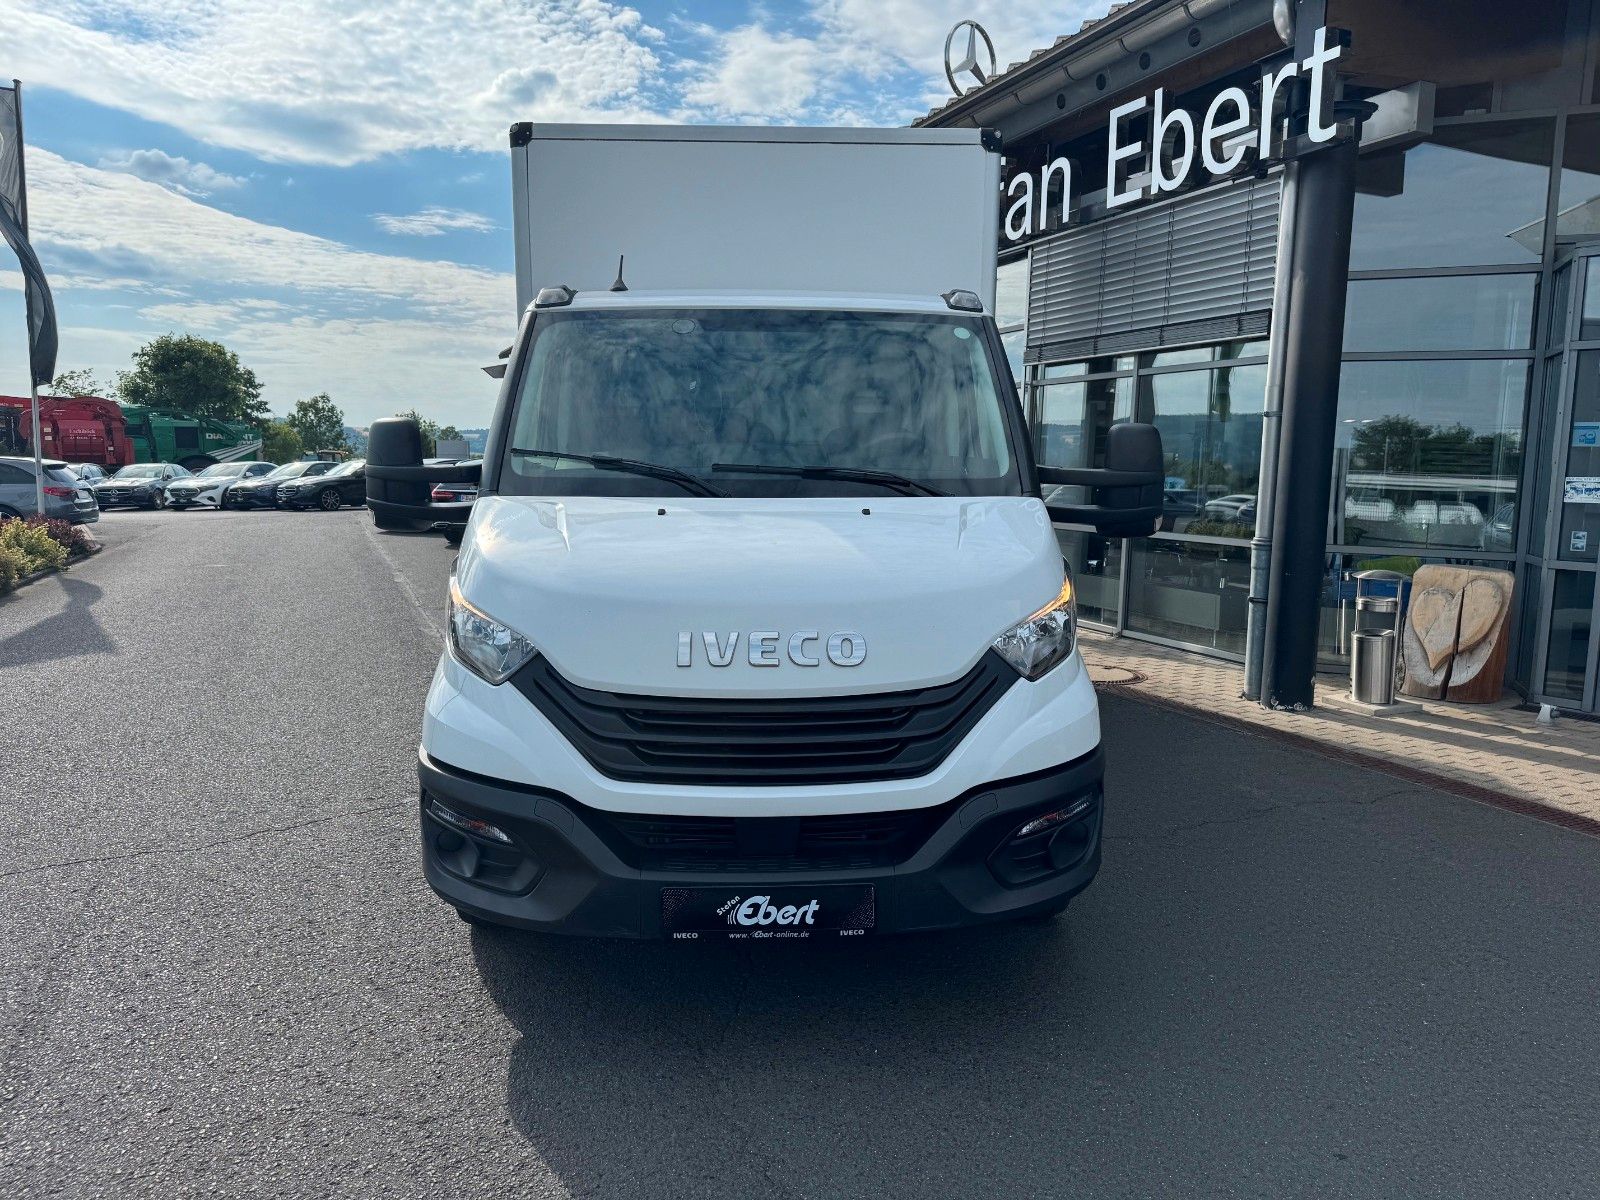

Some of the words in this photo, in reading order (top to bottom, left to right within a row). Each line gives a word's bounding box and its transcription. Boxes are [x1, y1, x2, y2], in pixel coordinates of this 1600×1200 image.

[1106, 25, 1342, 210] Ebert
[676, 631, 867, 667] IVECO
[716, 895, 741, 916] Stefan
[736, 895, 820, 926] Ebert
